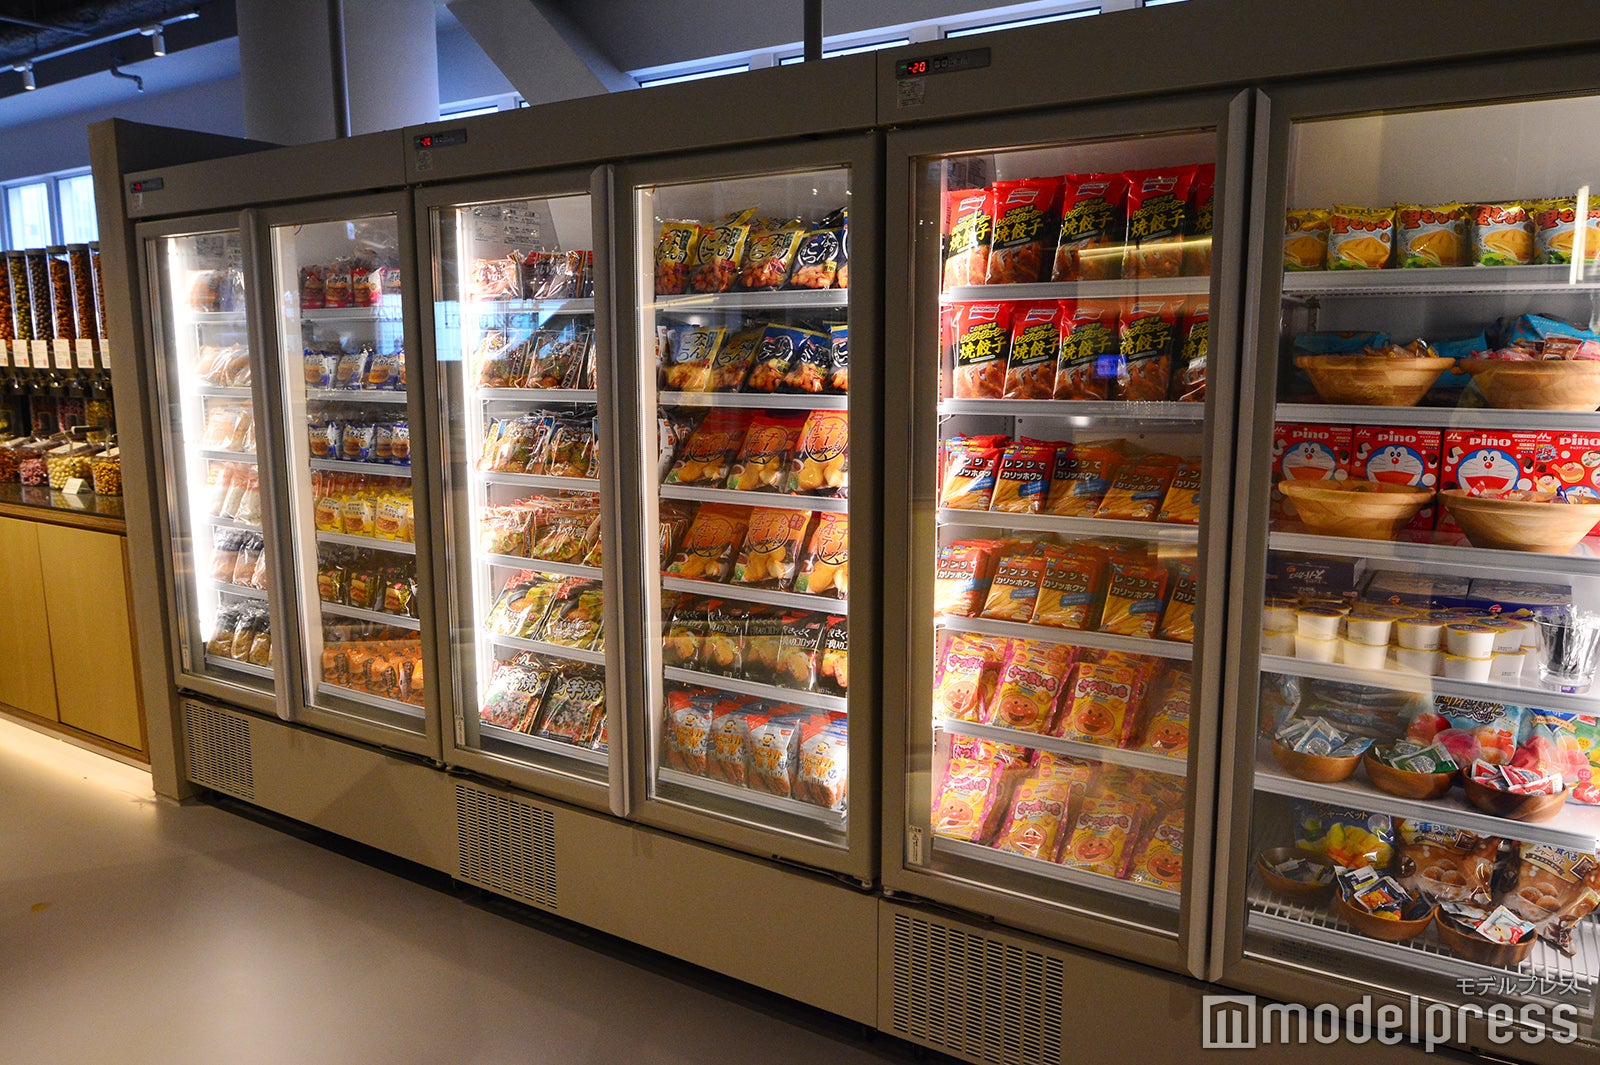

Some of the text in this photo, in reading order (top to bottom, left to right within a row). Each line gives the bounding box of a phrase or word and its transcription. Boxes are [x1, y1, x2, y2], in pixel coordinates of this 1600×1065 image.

[908, 61, 926, 74] -20
[1062, 211, 1113, 236] 焼餃子
[1131, 209, 1185, 237] 焼餃子
[993, 218, 1044, 242] 焼餃子
[959, 336, 1007, 360] 焼餃子
[1012, 336, 1060, 360] 焼餃子
[1062, 336, 1111, 361] 焼餃子
[1120, 331, 1171, 354] 焼餃子
[808, 420, 824, 454] ポテト
[1292, 428, 1329, 440] pino
[1377, 431, 1416, 443] pino
[1469, 434, 1511, 446] pino
[1559, 434, 1600, 446] pino
[1004, 460, 1046, 469] レンジで
[1057, 459, 1101, 469] レンジで
[1001, 470, 1043, 480] カリッホクッ
[820, 523, 836, 558] ポテト
[998, 567, 1040, 577] レンジで
[1046, 568, 1089, 582] レンジで
[995, 576, 1037, 587] カリッホクッ
[1043, 579, 1086, 592] カリッホクッ
[1114, 575, 1160, 588] レンジで
[1111, 586, 1157, 599] カリッホクッ
[1319, 808, 1368, 820] シャーベット
[1535, 846, 1566, 864] シャーベット
